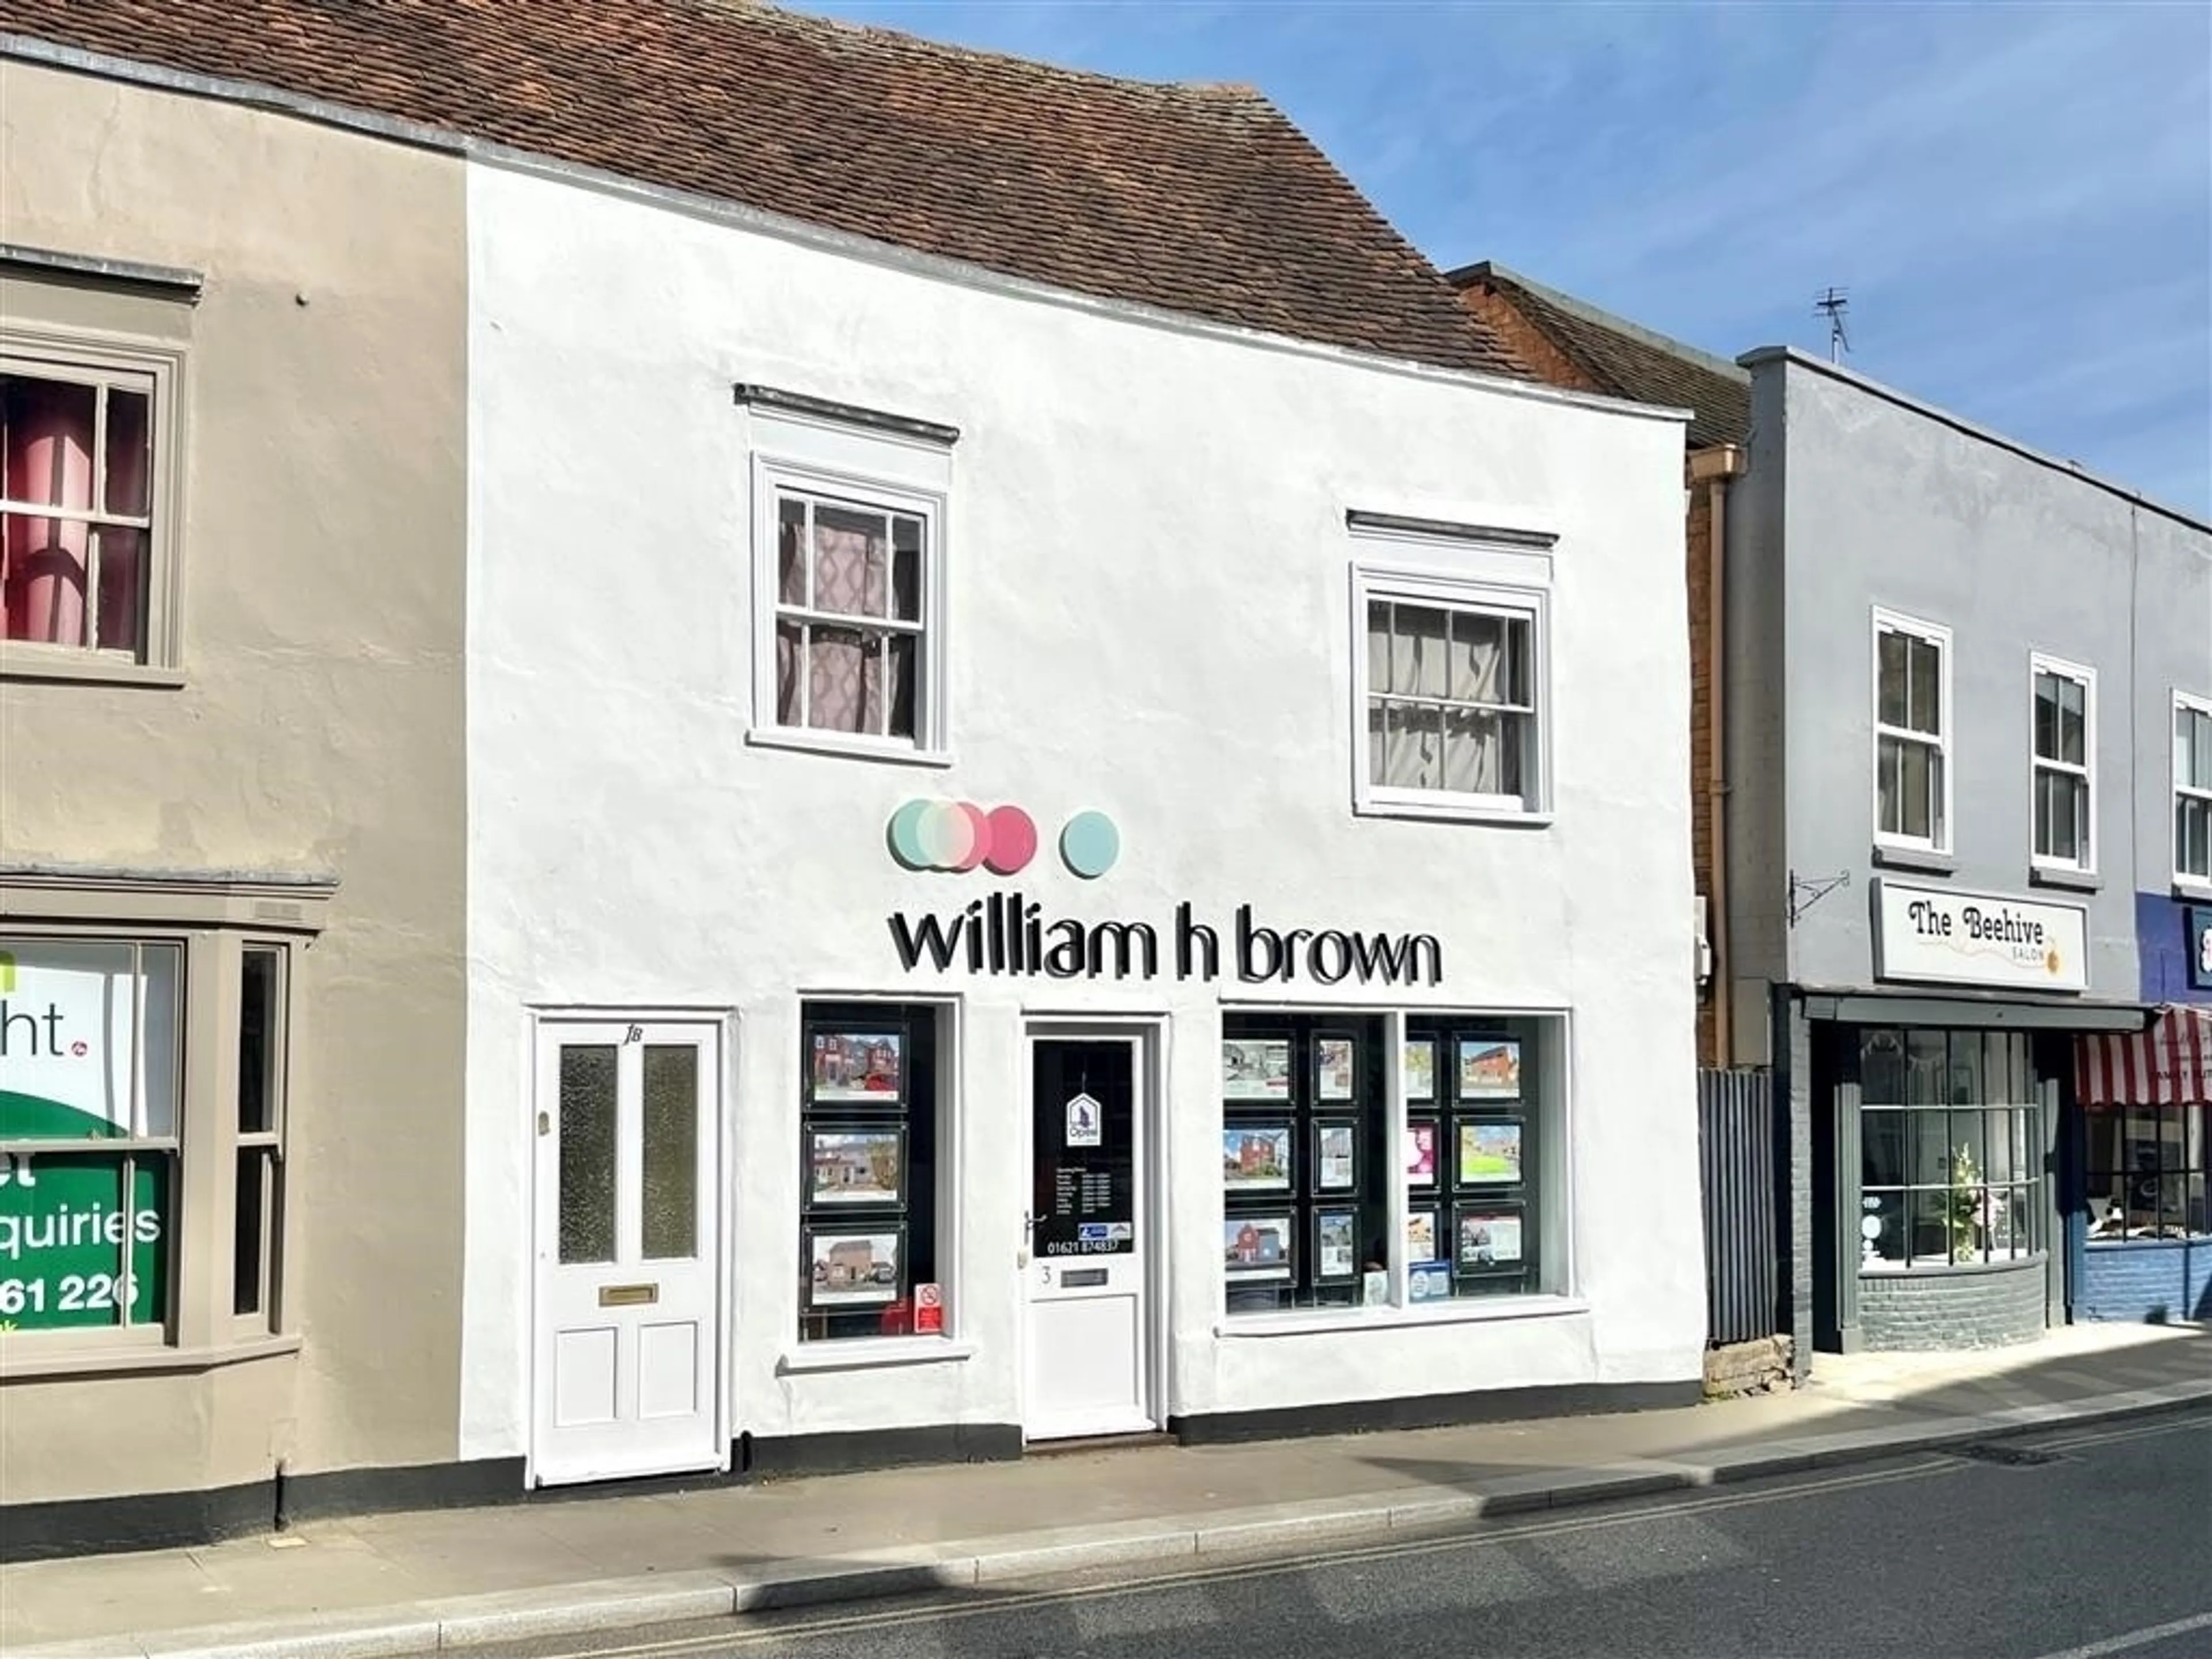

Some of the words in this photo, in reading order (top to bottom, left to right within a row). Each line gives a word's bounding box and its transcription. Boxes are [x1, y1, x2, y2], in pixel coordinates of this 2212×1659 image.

[887, 892, 1158, 980] william
[1176, 901, 1219, 982] h
[1236, 903, 1442, 988] brown
[1908, 900, 1952, 937] The
[1962, 906, 2044, 945] Beehive
[1041, 1265, 1051, 1284] 3
